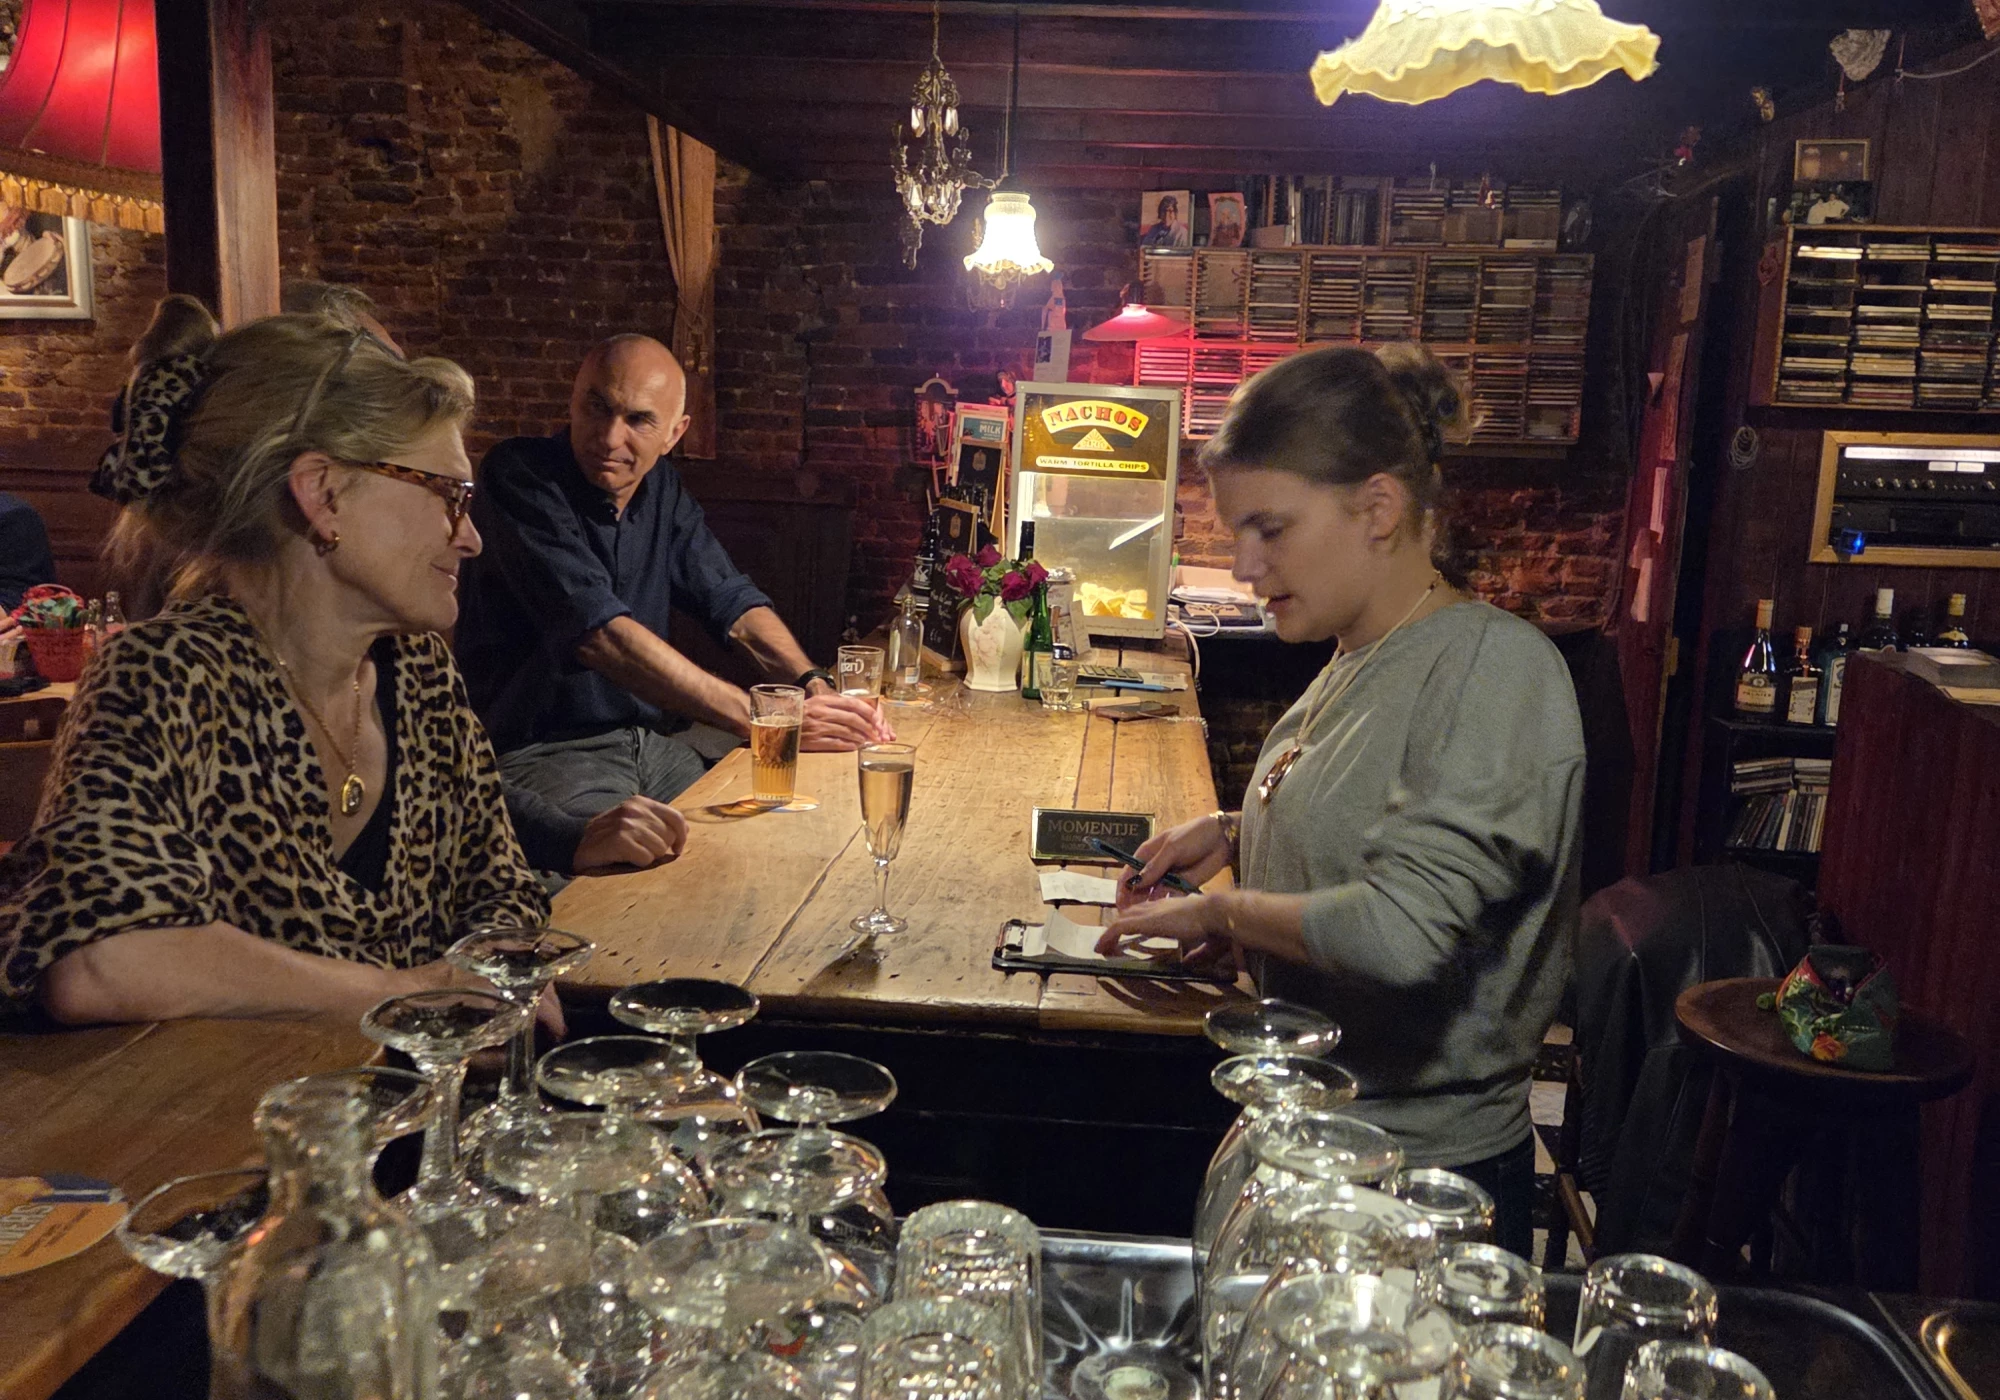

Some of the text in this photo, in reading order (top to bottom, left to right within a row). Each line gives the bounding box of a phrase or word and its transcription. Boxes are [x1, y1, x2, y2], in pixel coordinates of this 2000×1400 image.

[1048, 406, 1142, 432] NACHOS
[979, 424, 1001, 434] MILK
[1073, 460, 1114, 468] TORTILLA
[1118, 462, 1147, 470] CHIPS
[1047, 819, 1139, 836] MOMENTJE
